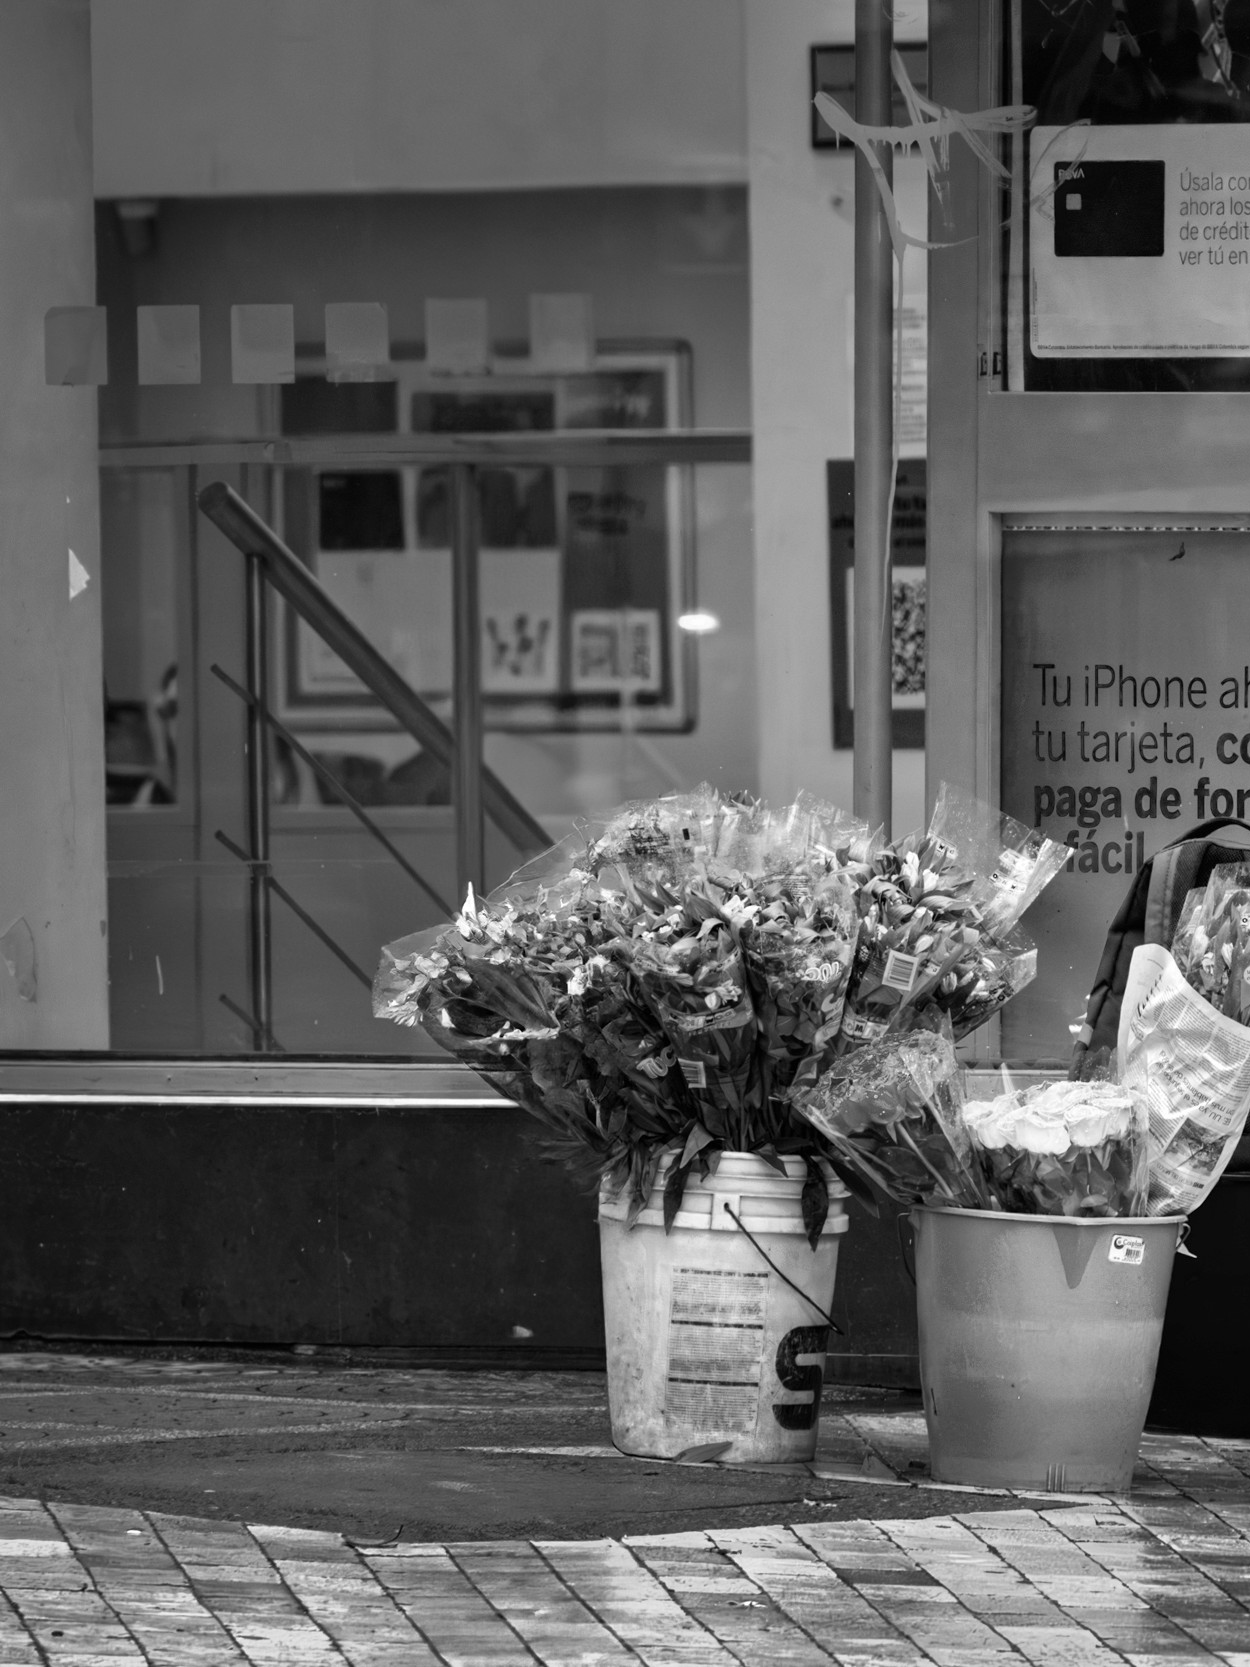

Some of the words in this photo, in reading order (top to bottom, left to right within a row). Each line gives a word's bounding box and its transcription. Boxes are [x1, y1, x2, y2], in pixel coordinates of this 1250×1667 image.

[1180, 168, 1224, 192] Úsala
[1180, 197, 1225, 216] ahora
[1179, 222, 1199, 241] de
[1179, 250, 1204, 266] ver
[1208, 246, 1224, 265] tú
[1228, 250, 1249, 265] en
[1033, 664, 1072, 707] Tu
[1084, 664, 1208, 708] iPhone
[1032, 721, 1067, 762] tu
[1077, 721, 1205, 774] tarjeta,
[1033, 782, 1123, 828] paga
[1134, 776, 1182, 820] de
[1064, 829, 1145, 875] fácil
